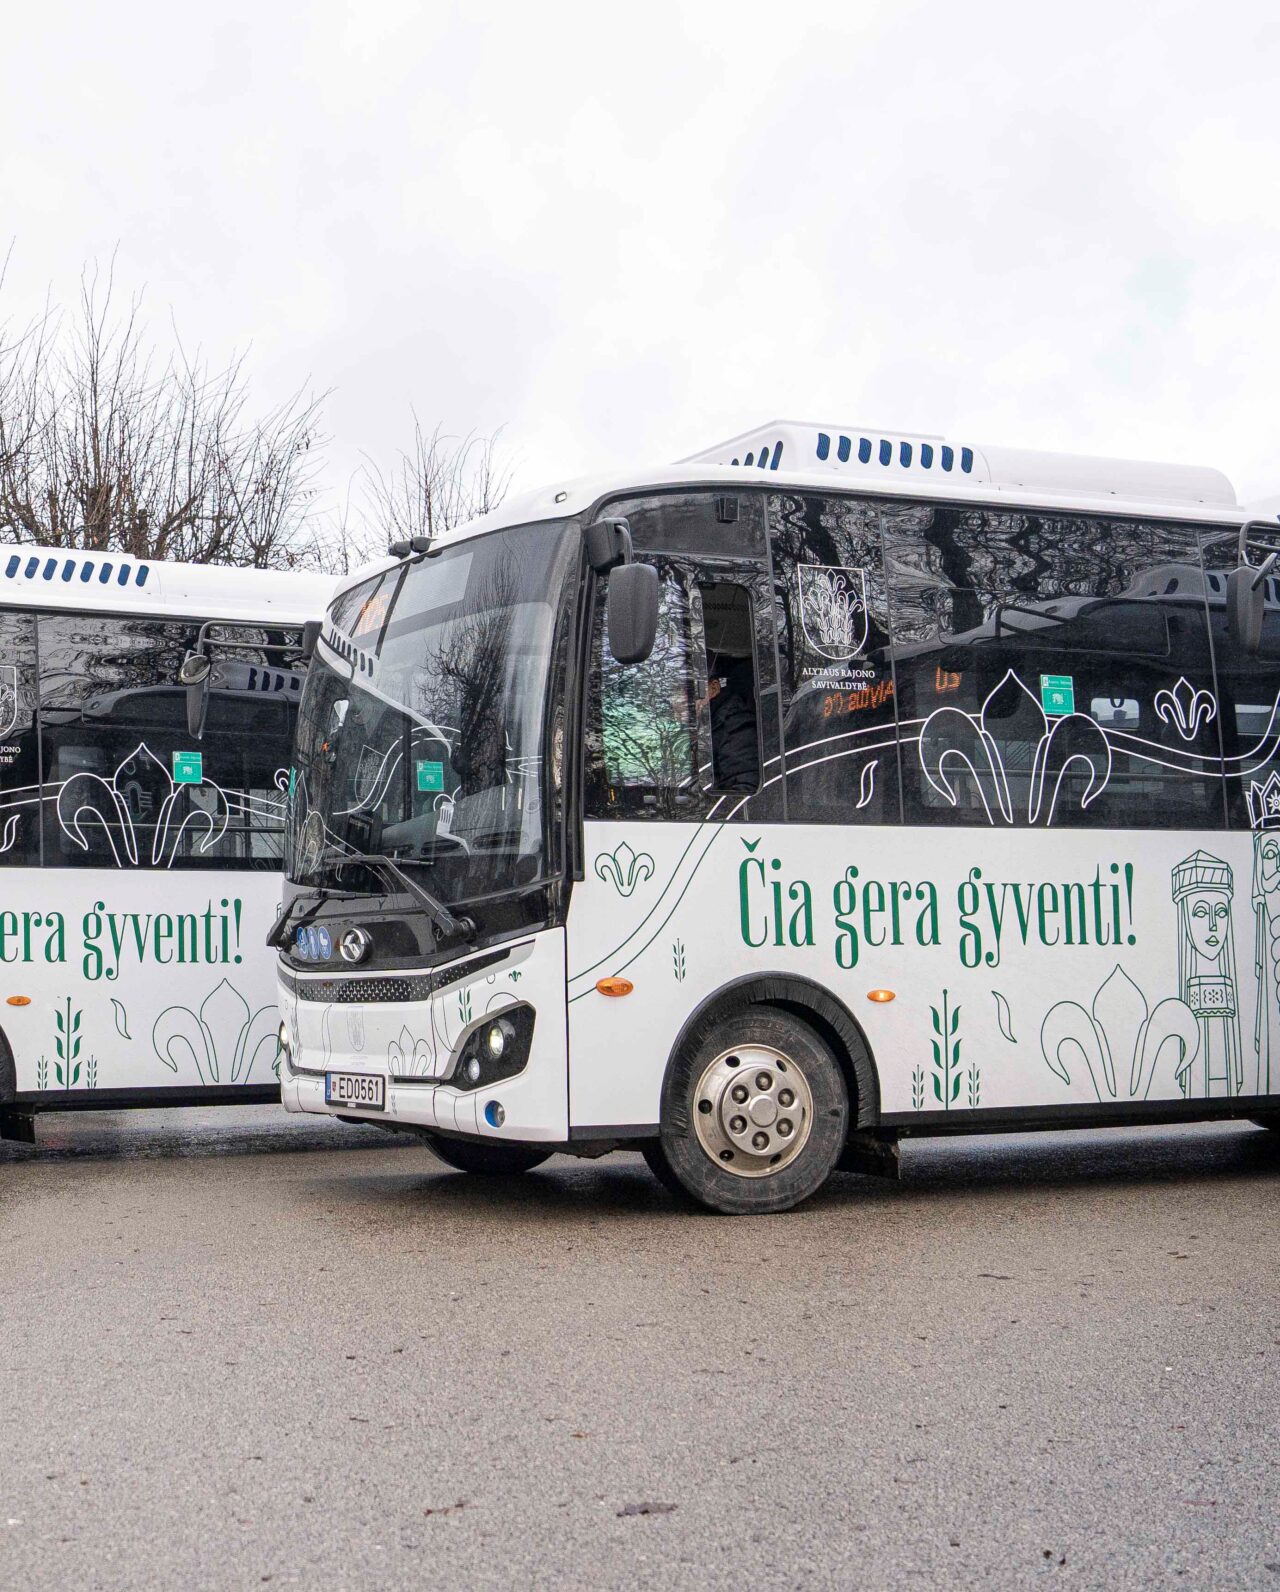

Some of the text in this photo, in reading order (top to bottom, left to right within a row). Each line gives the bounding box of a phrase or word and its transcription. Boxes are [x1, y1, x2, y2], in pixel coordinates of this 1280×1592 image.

[802, 667, 876, 680] ALYTAUS RAJONO
[811, 680, 868, 691] SAVIVALDYBĖ
[738, 836, 1137, 969] Čia gera gyventi!
[82, 898, 243, 981] gyventi!
[339, 1077, 379, 1102] ED0561
